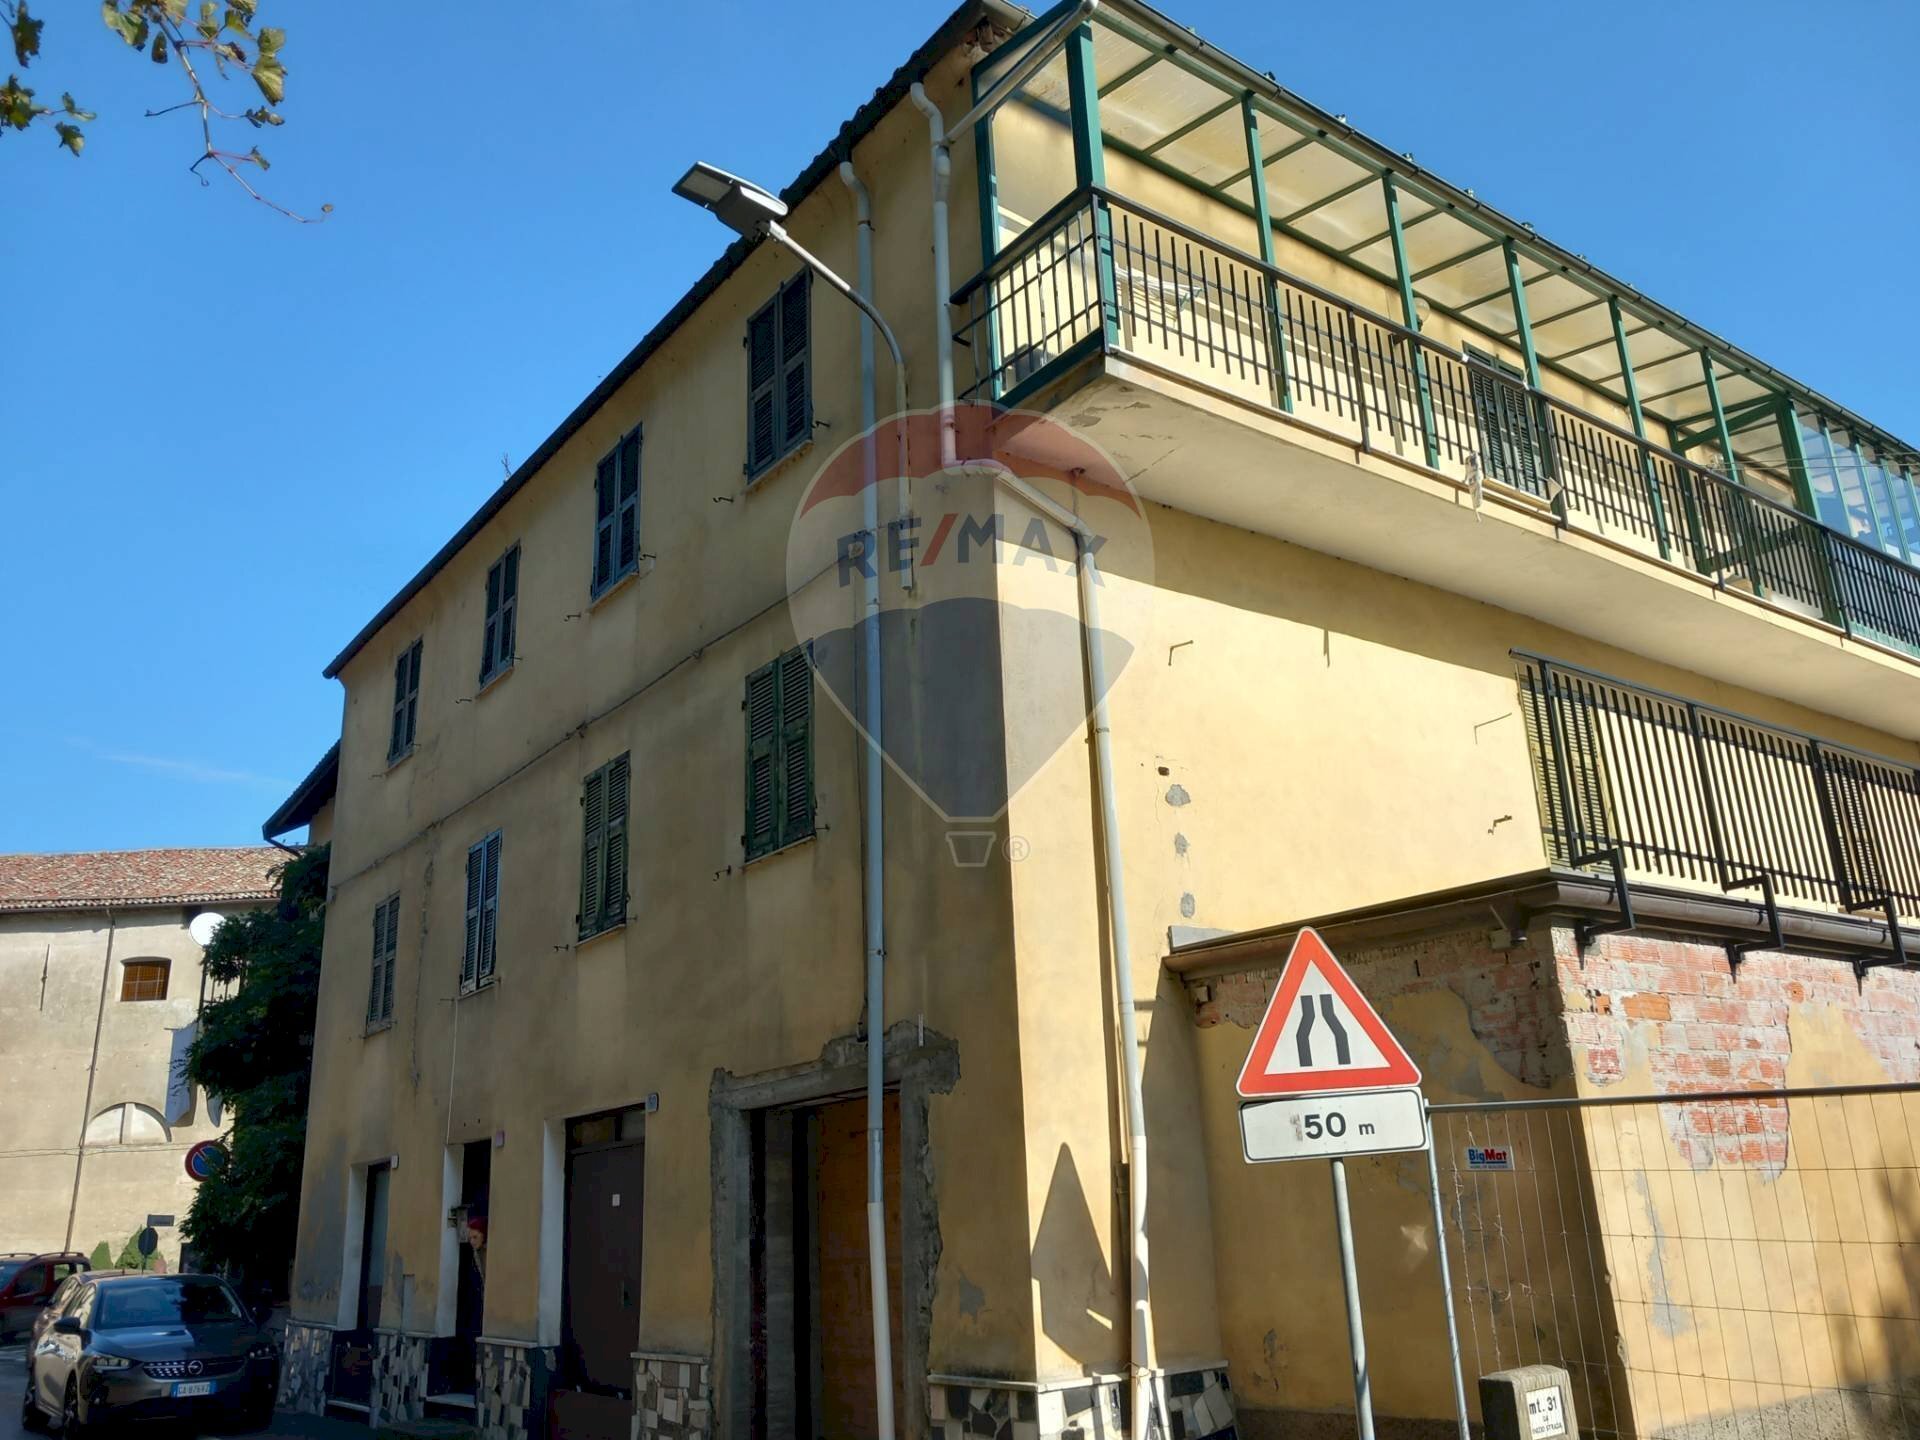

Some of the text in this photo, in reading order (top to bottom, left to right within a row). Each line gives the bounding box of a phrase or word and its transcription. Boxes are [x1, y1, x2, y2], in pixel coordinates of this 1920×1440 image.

[1304, 1112, 1375, 1140] 50 m
[1468, 1148, 1507, 1164] BigMat
[1529, 1396, 1557, 1415] mt. 31
